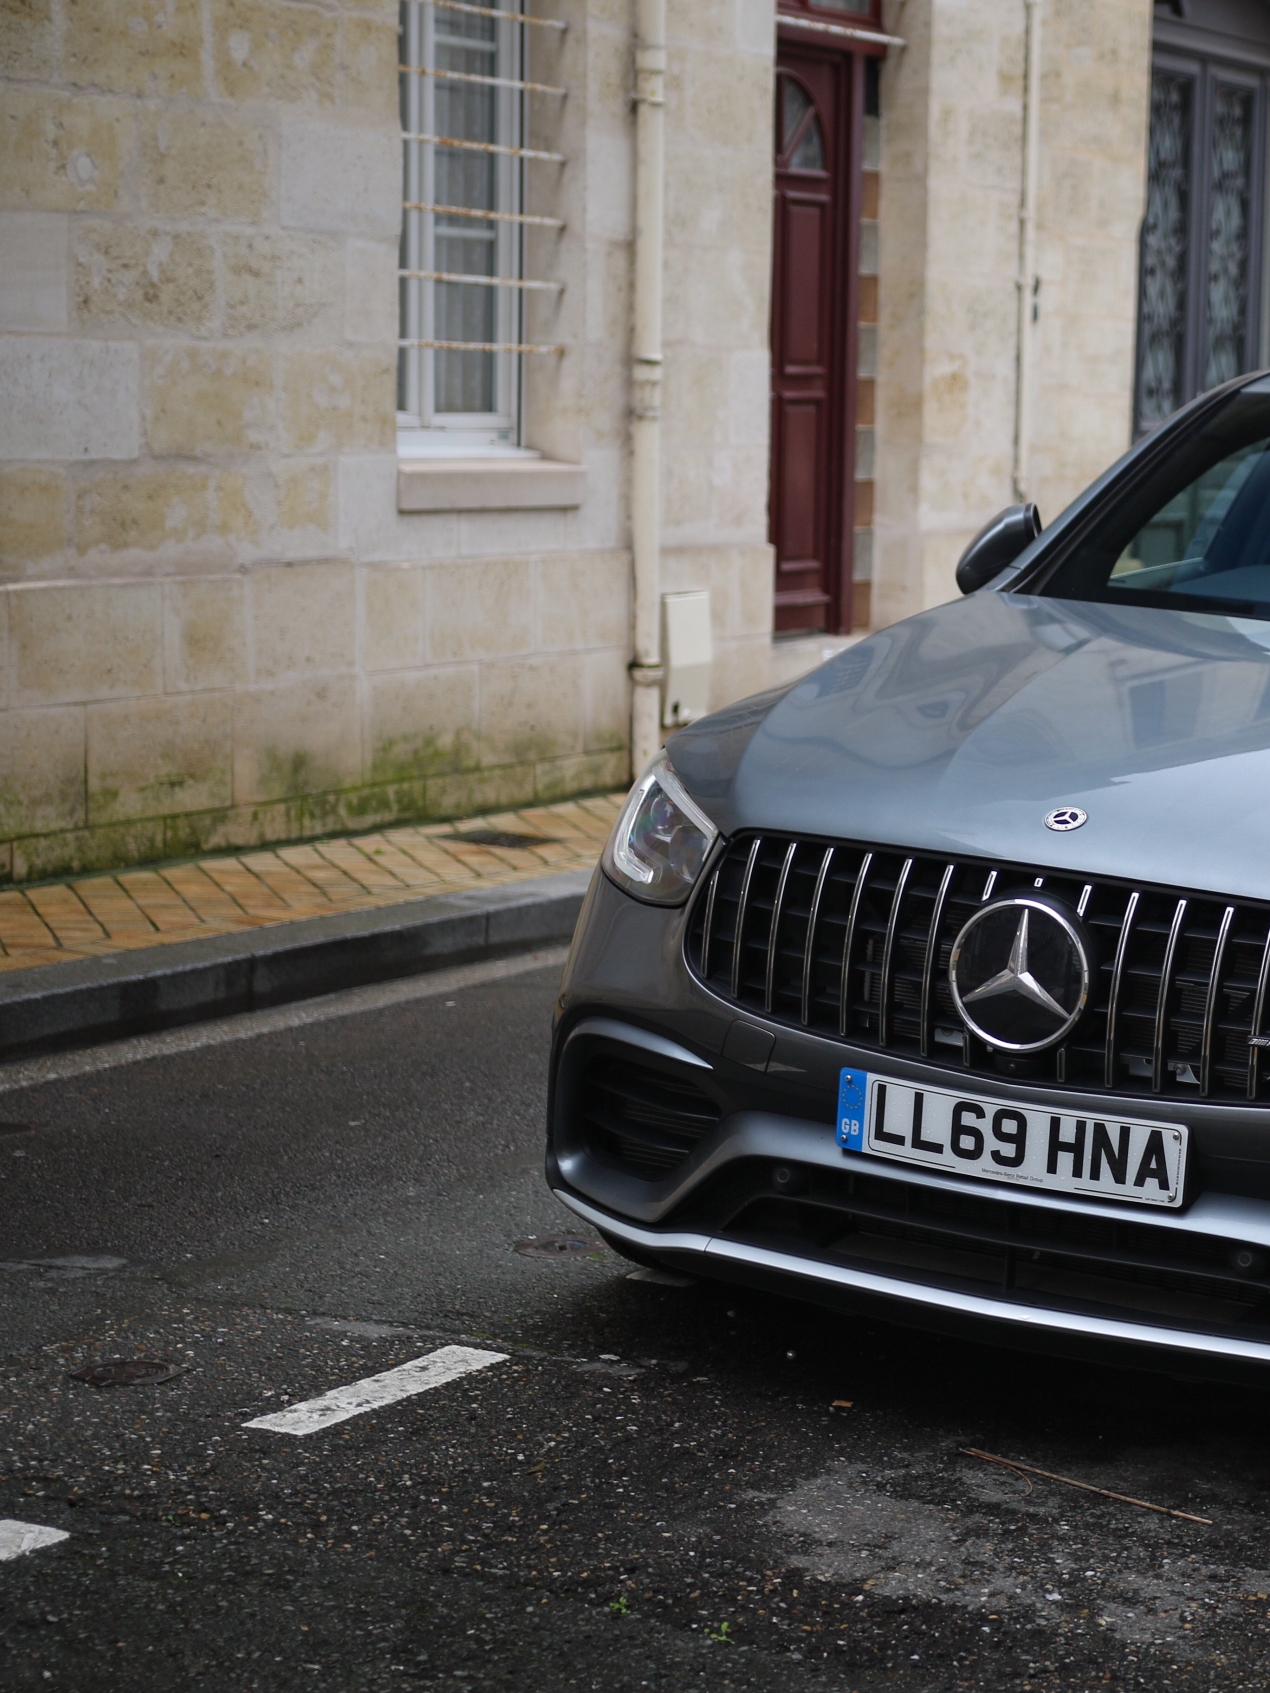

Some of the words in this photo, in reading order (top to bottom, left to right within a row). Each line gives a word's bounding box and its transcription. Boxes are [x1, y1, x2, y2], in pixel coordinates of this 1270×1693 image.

[841, 1117, 860, 1136] GB
[874, 1083, 1028, 1169] LL69
[1046, 1115, 1171, 1192] HNA
[981, 1167, 1015, 1178] Mercedes-Benz
